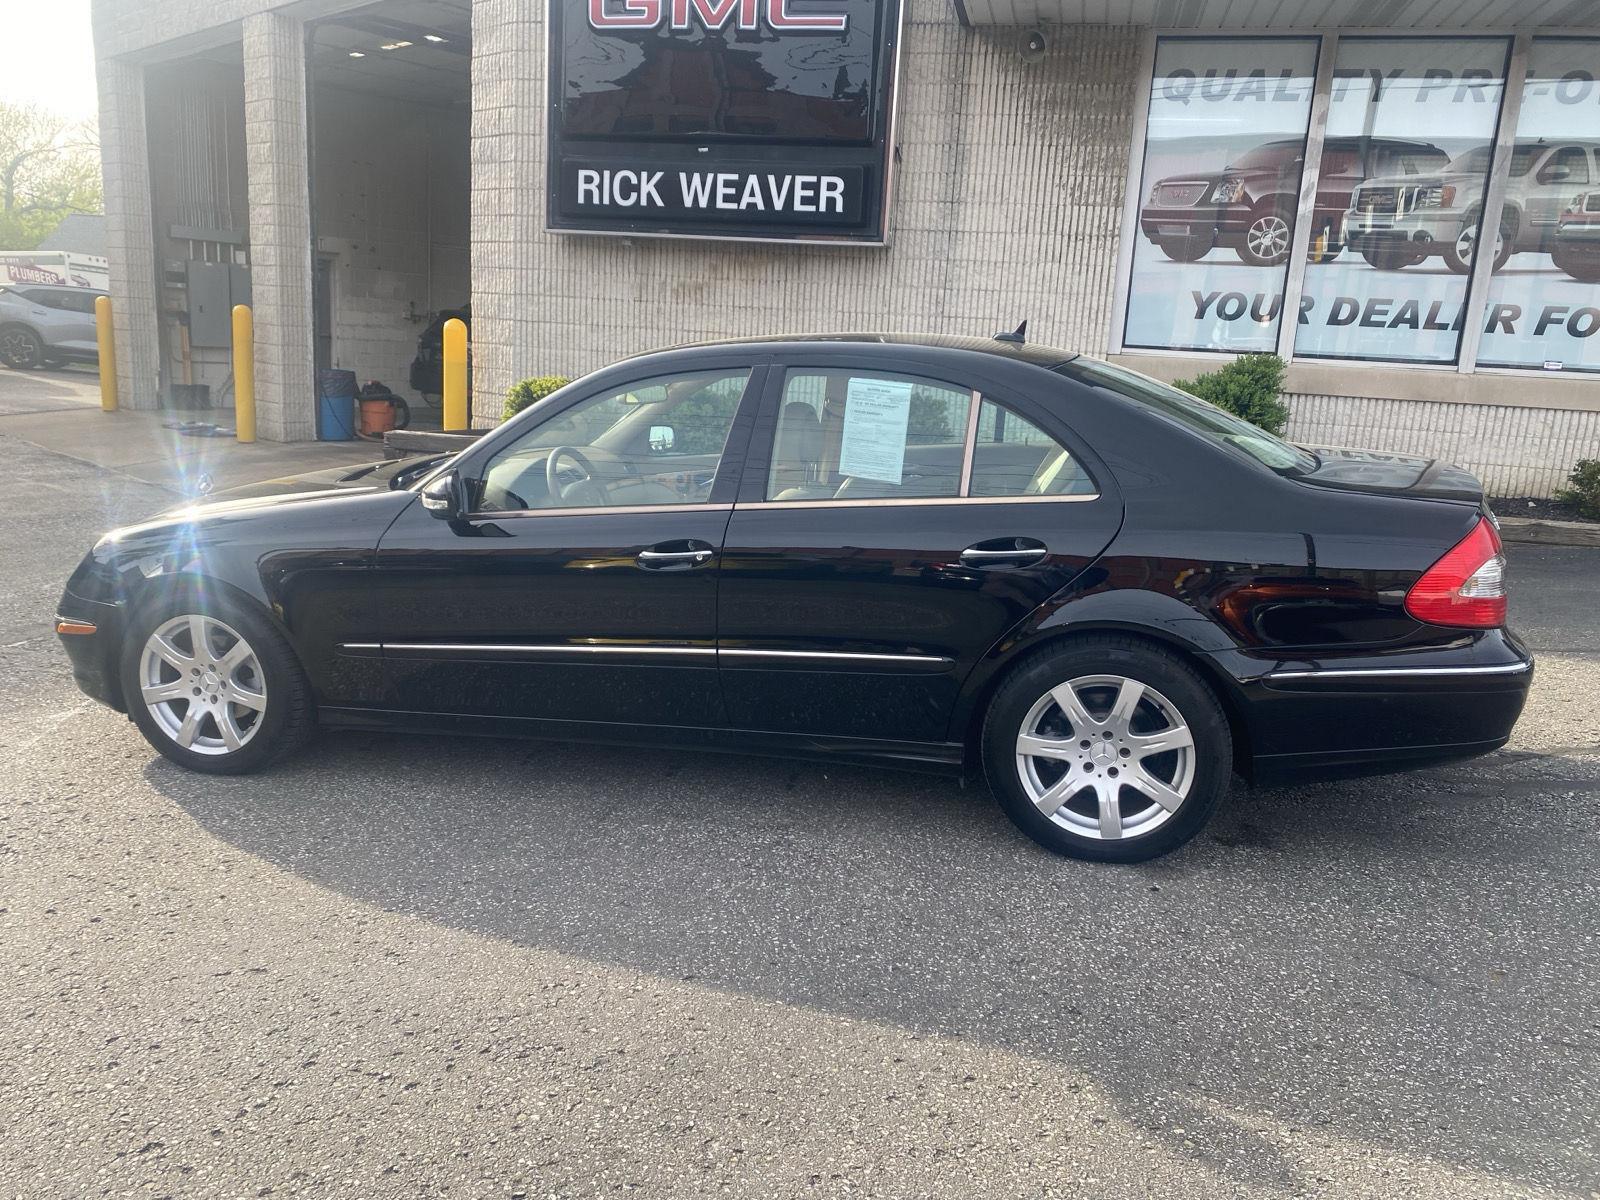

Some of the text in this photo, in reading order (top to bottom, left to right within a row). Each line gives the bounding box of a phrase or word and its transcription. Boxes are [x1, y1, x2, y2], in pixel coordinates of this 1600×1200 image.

[1162, 68, 1600, 106] QUALTY PR-O
[577, 169, 845, 213] RICK WEAVER
[10, 266, 57, 284] PLUMBERS
